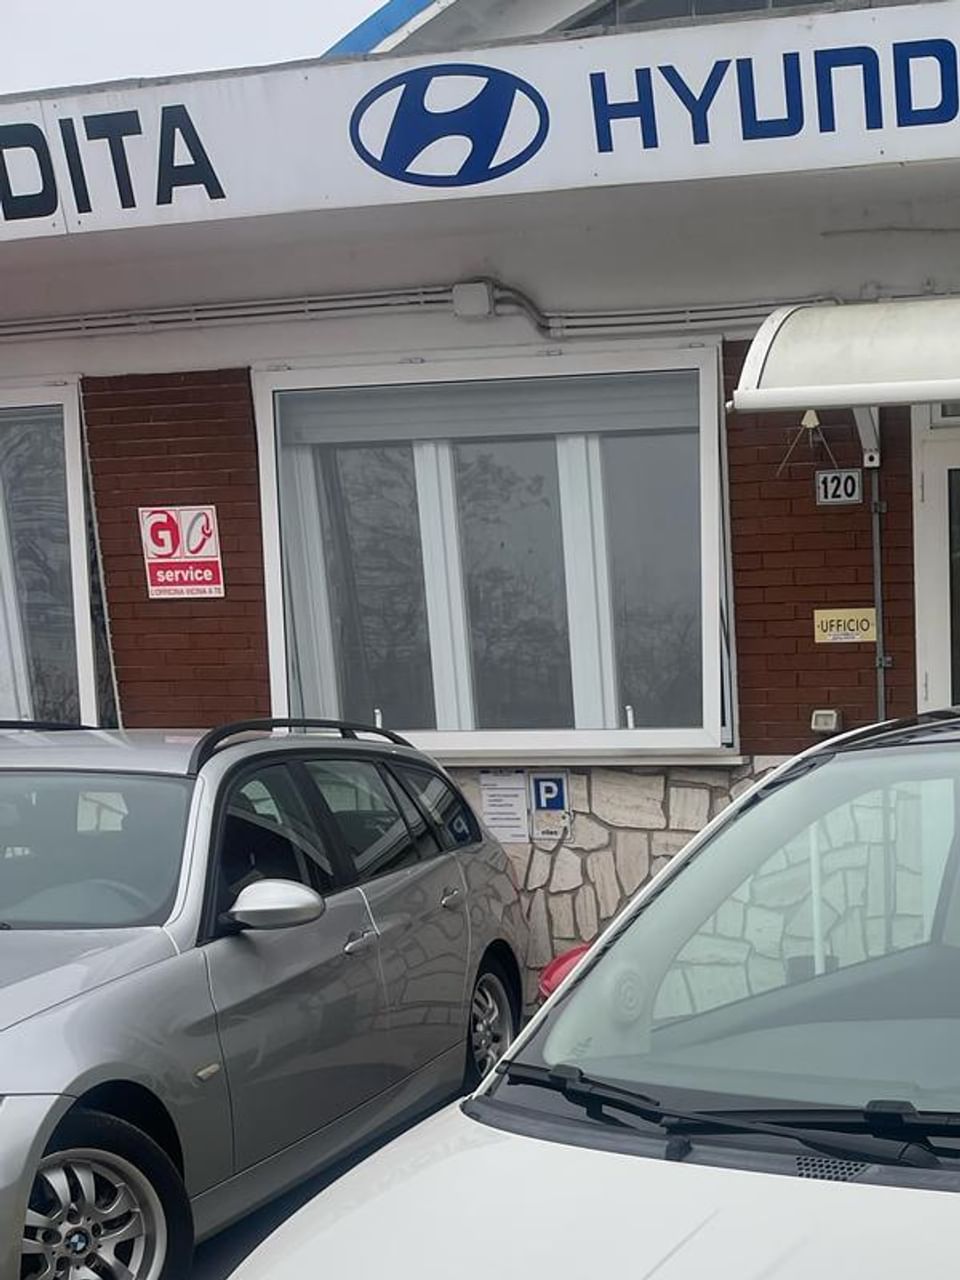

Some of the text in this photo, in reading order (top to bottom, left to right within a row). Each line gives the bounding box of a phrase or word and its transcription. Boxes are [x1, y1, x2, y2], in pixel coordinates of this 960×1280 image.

[820, 475, 856, 499] 120
[156, 566, 213, 582] service
[539, 781, 558, 808] P
